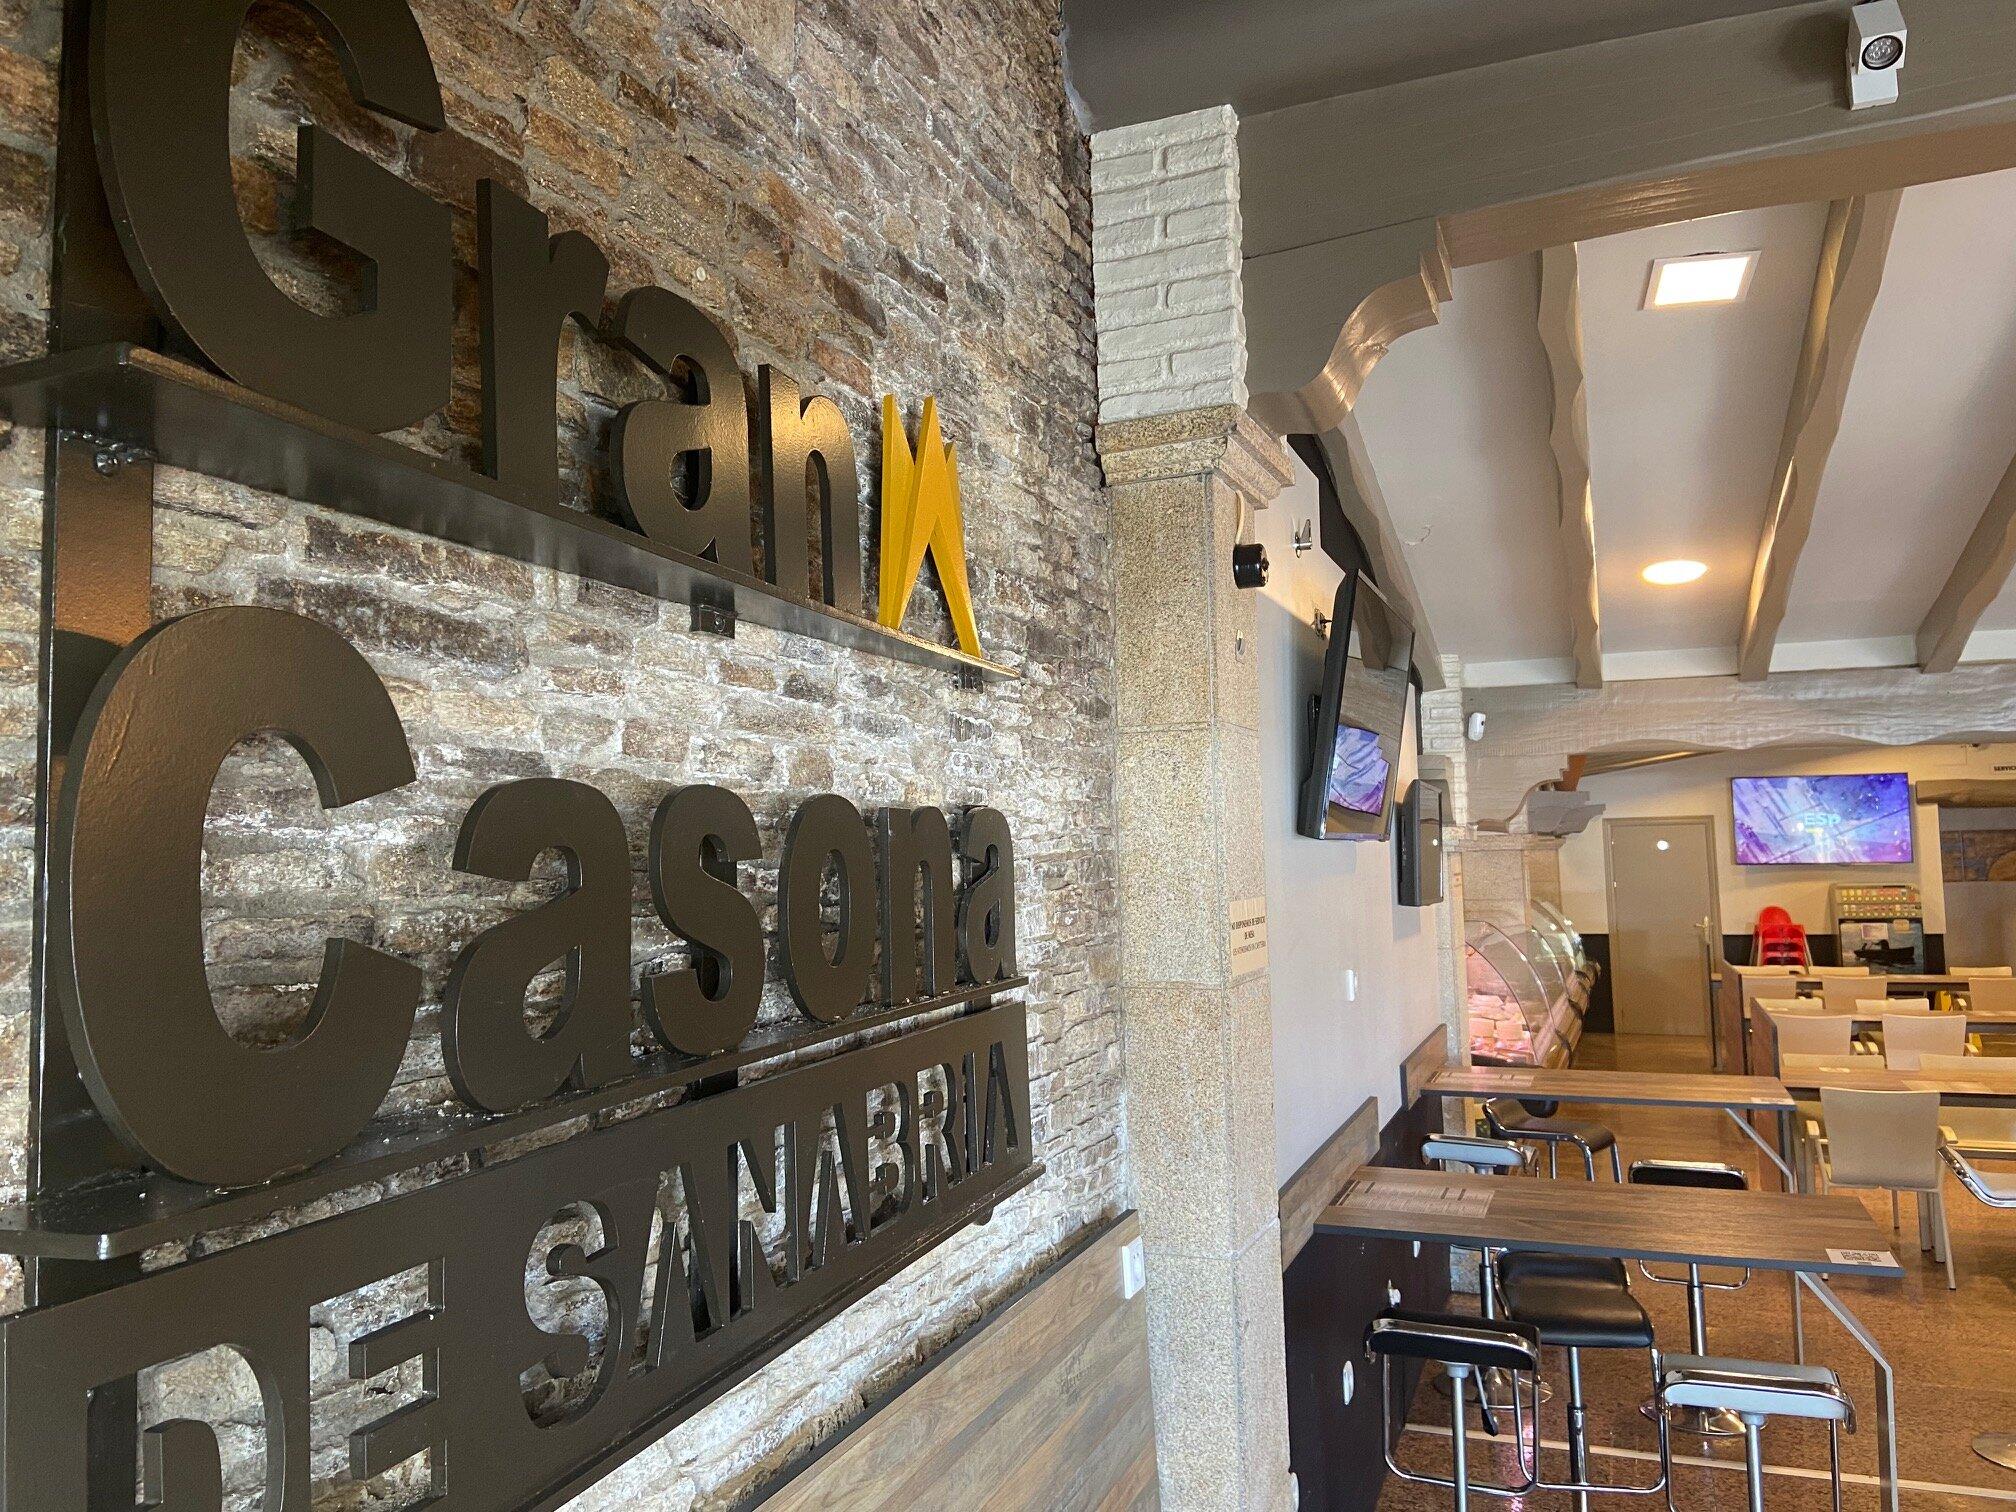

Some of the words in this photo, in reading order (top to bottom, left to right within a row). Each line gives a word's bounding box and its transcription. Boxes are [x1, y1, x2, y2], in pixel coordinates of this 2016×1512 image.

[92, 0, 862, 612] Gran
[68, 606, 1016, 1186] Casona
[519, 1041, 1018, 1429] SANABRIA
